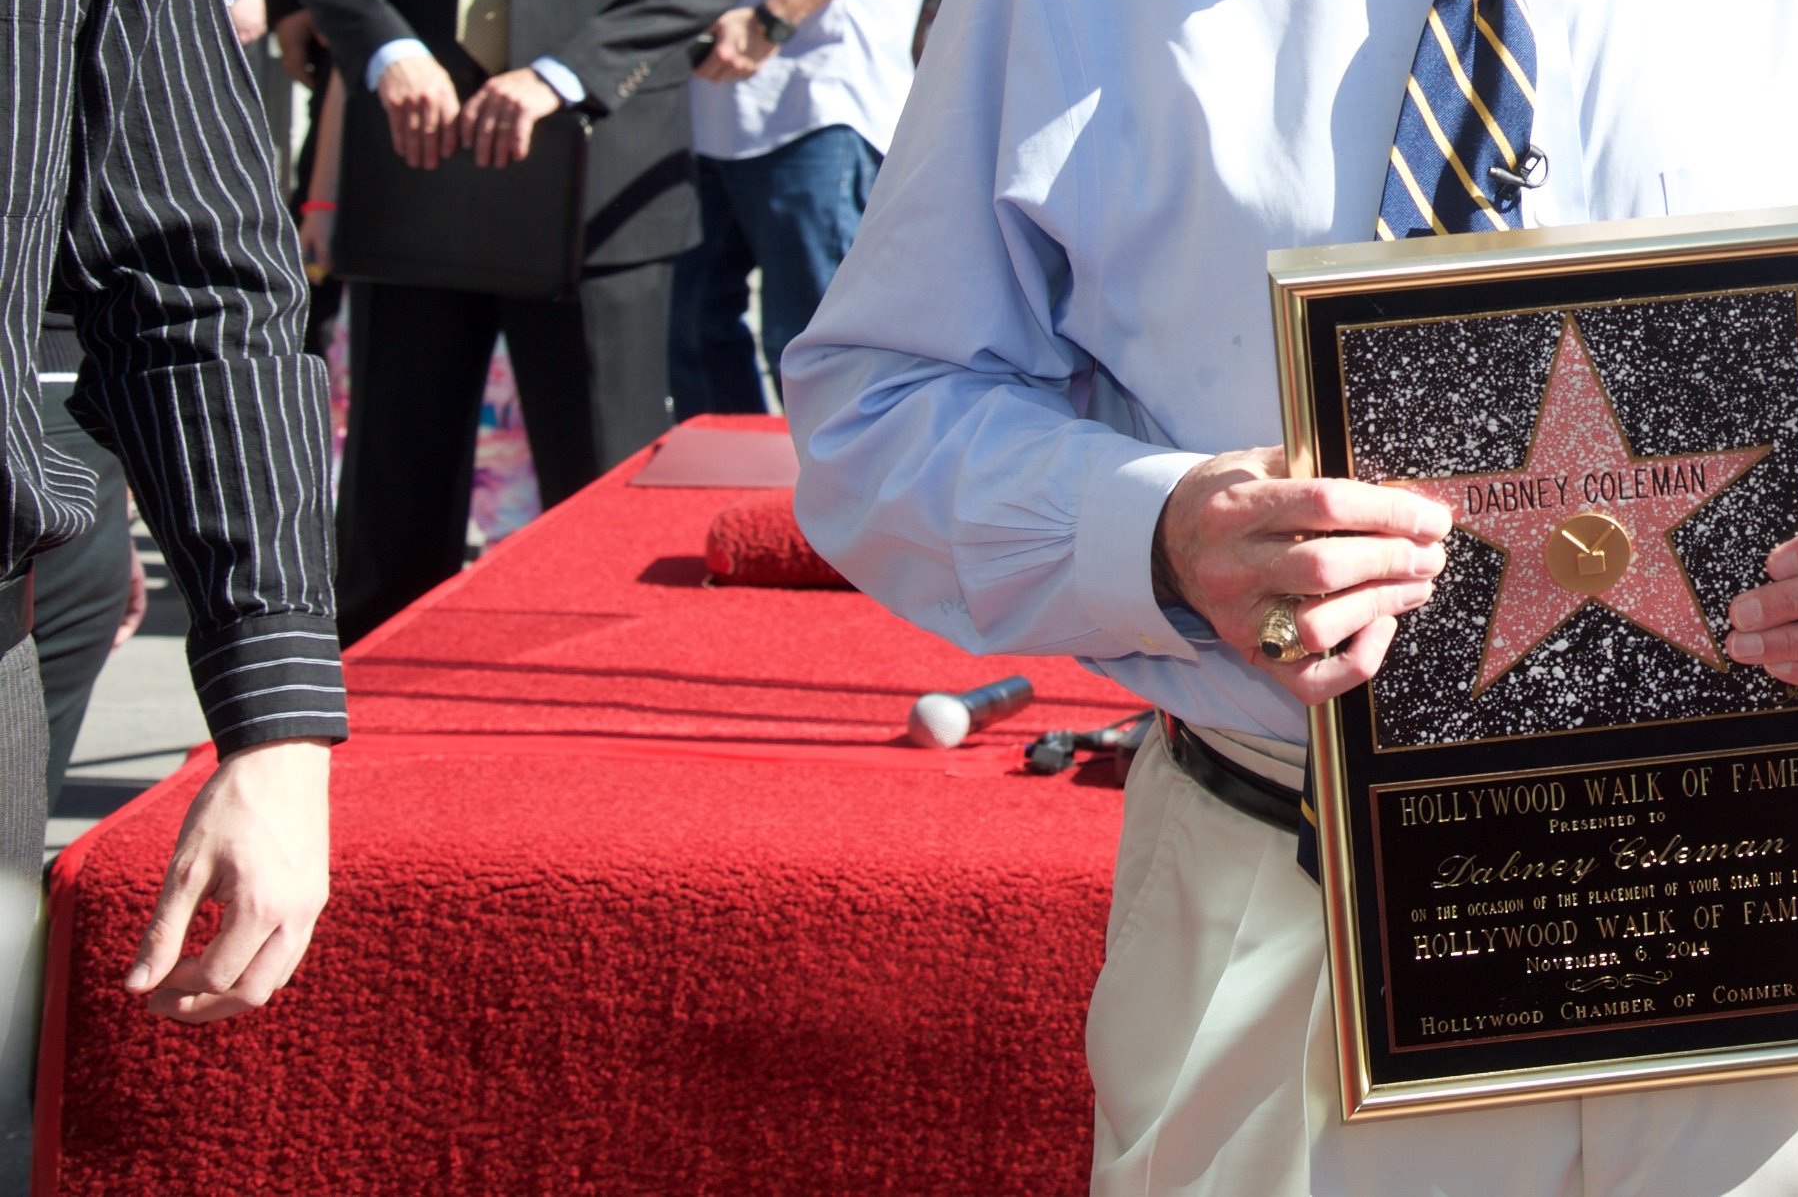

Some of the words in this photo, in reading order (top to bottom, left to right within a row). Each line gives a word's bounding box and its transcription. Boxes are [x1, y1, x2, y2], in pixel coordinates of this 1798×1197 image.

[1467, 476, 1568, 515] DABNEY
[1583, 463, 1706, 504] COLEMAN
[1400, 781, 1566, 826] HOLLYWOOD
[1584, 771, 1664, 806] WALK
[1682, 766, 1713, 798] OF
[1648, 811, 1666, 823] TO
[1430, 851, 1600, 889] Dabney
[1609, 834, 1790, 870] Coleman
[1411, 907, 1427, 923] ON
[1436, 905, 1458, 921] THE
[1467, 899, 1524, 917] OCCASION
[1533, 895, 1547, 910] OF
[1557, 892, 1579, 908] THE
[1588, 884, 1656, 905] PLACEMENT
[1664, 882, 1679, 897] OF
[1689, 877, 1721, 895] YOUR
[1730, 873, 1761, 890] STAR
[1769, 871, 1783, 886] IN
[1413, 919, 1578, 960] HOLLYWOOD
[1595, 909, 1676, 939] WALK
[1693, 904, 1724, 930] OF
[1666, 940, 1710, 959] 2014
[1420, 1010, 1544, 1035] HOLLYWOOD
[1673, 993, 1696, 1008] OF
